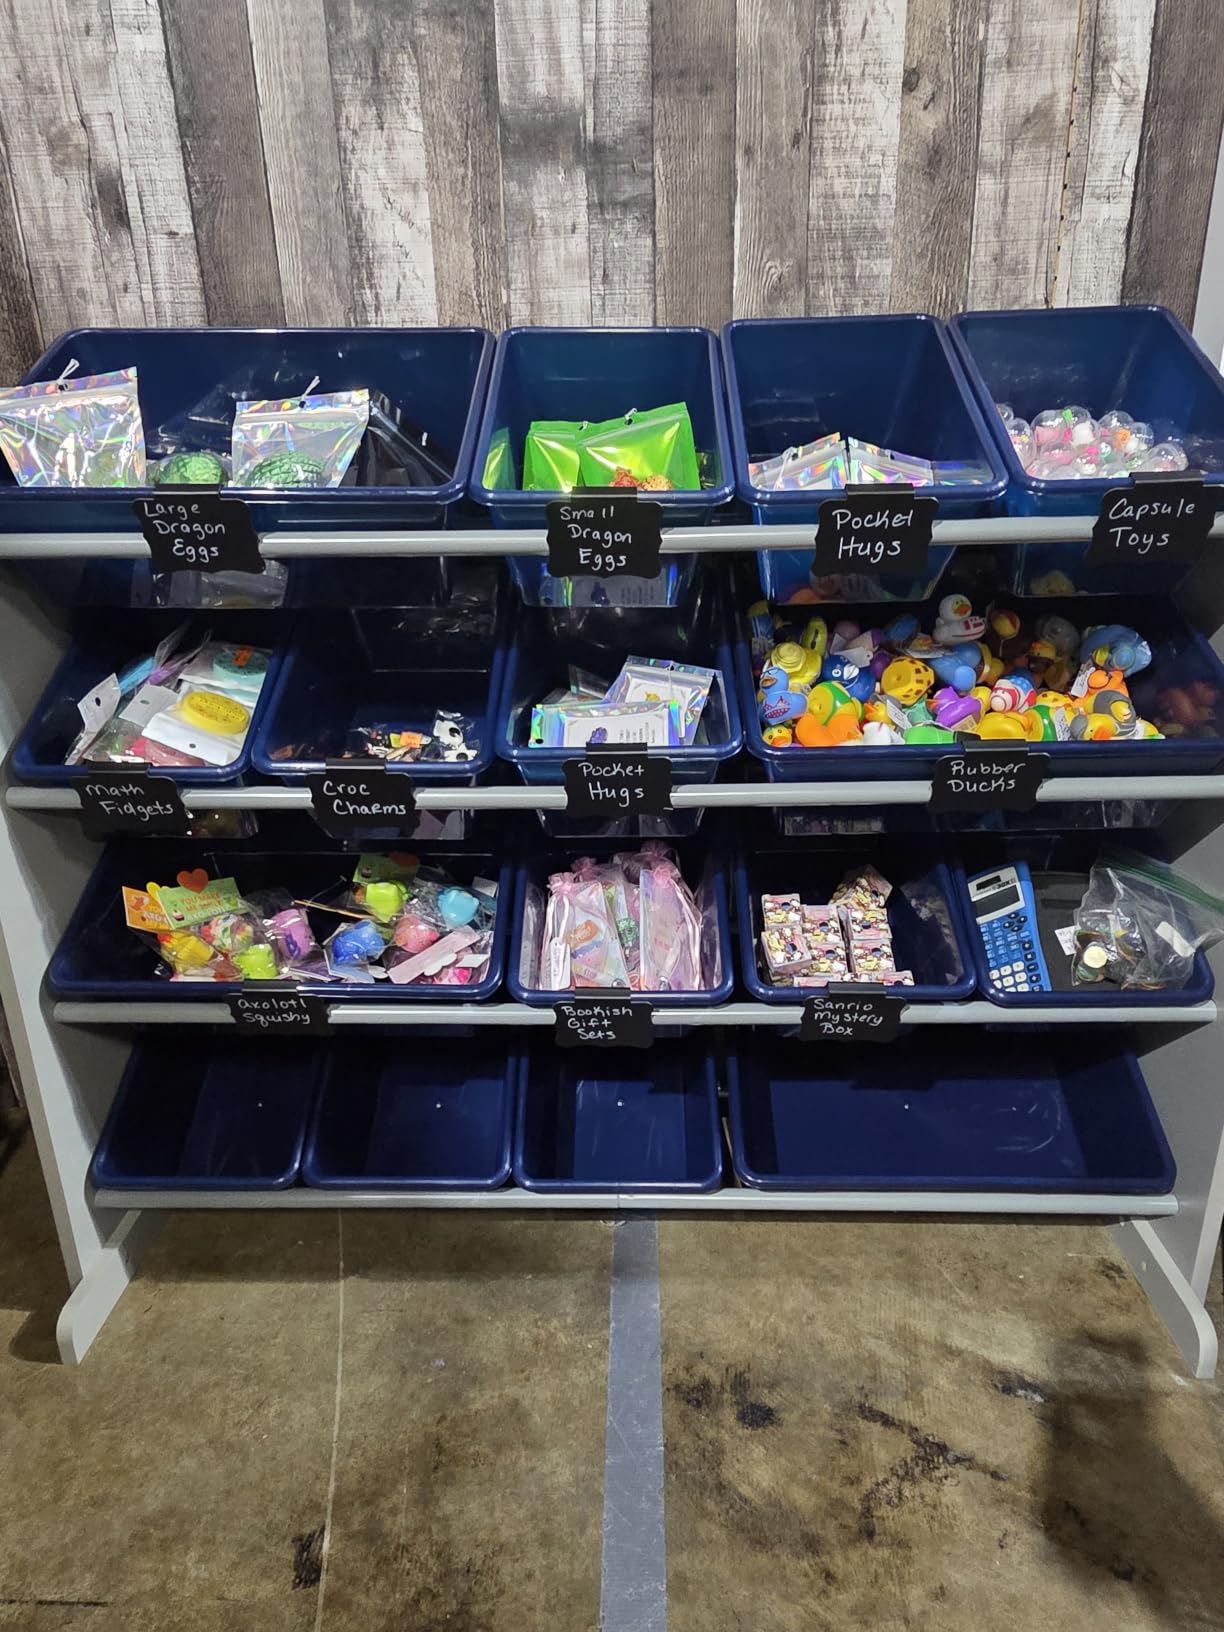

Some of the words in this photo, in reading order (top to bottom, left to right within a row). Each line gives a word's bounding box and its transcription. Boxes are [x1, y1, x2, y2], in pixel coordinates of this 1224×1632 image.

[144, 501, 201, 521] Large
[559, 505, 615, 521] Small
[1108, 497, 1196, 521] Capsule
[831, 508, 914, 531] Pocket
[152, 519, 226, 541] Dragon
[567, 523, 632, 549] Dragon
[172, 538, 219, 563] Eggs
[837, 535, 902, 564] Hugs
[1108, 526, 1171, 555] Toys
[578, 547, 627, 572] Eggs
[577, 761, 645, 777] Pocket
[949, 759, 1027, 776] Rubber
[322, 780, 371, 796] Croc
[588, 780, 645, 808] Hugs
[946, 776, 1017, 793] Ducks
[98, 800, 174, 821] Fidgets
[561, 1006, 633, 1018] Bookish
[813, 998, 873, 1011] Sanrio
[567, 1017, 612, 1029] Gift
[820, 1022, 853, 1036] Box
[577, 1028, 617, 1040] Sets
